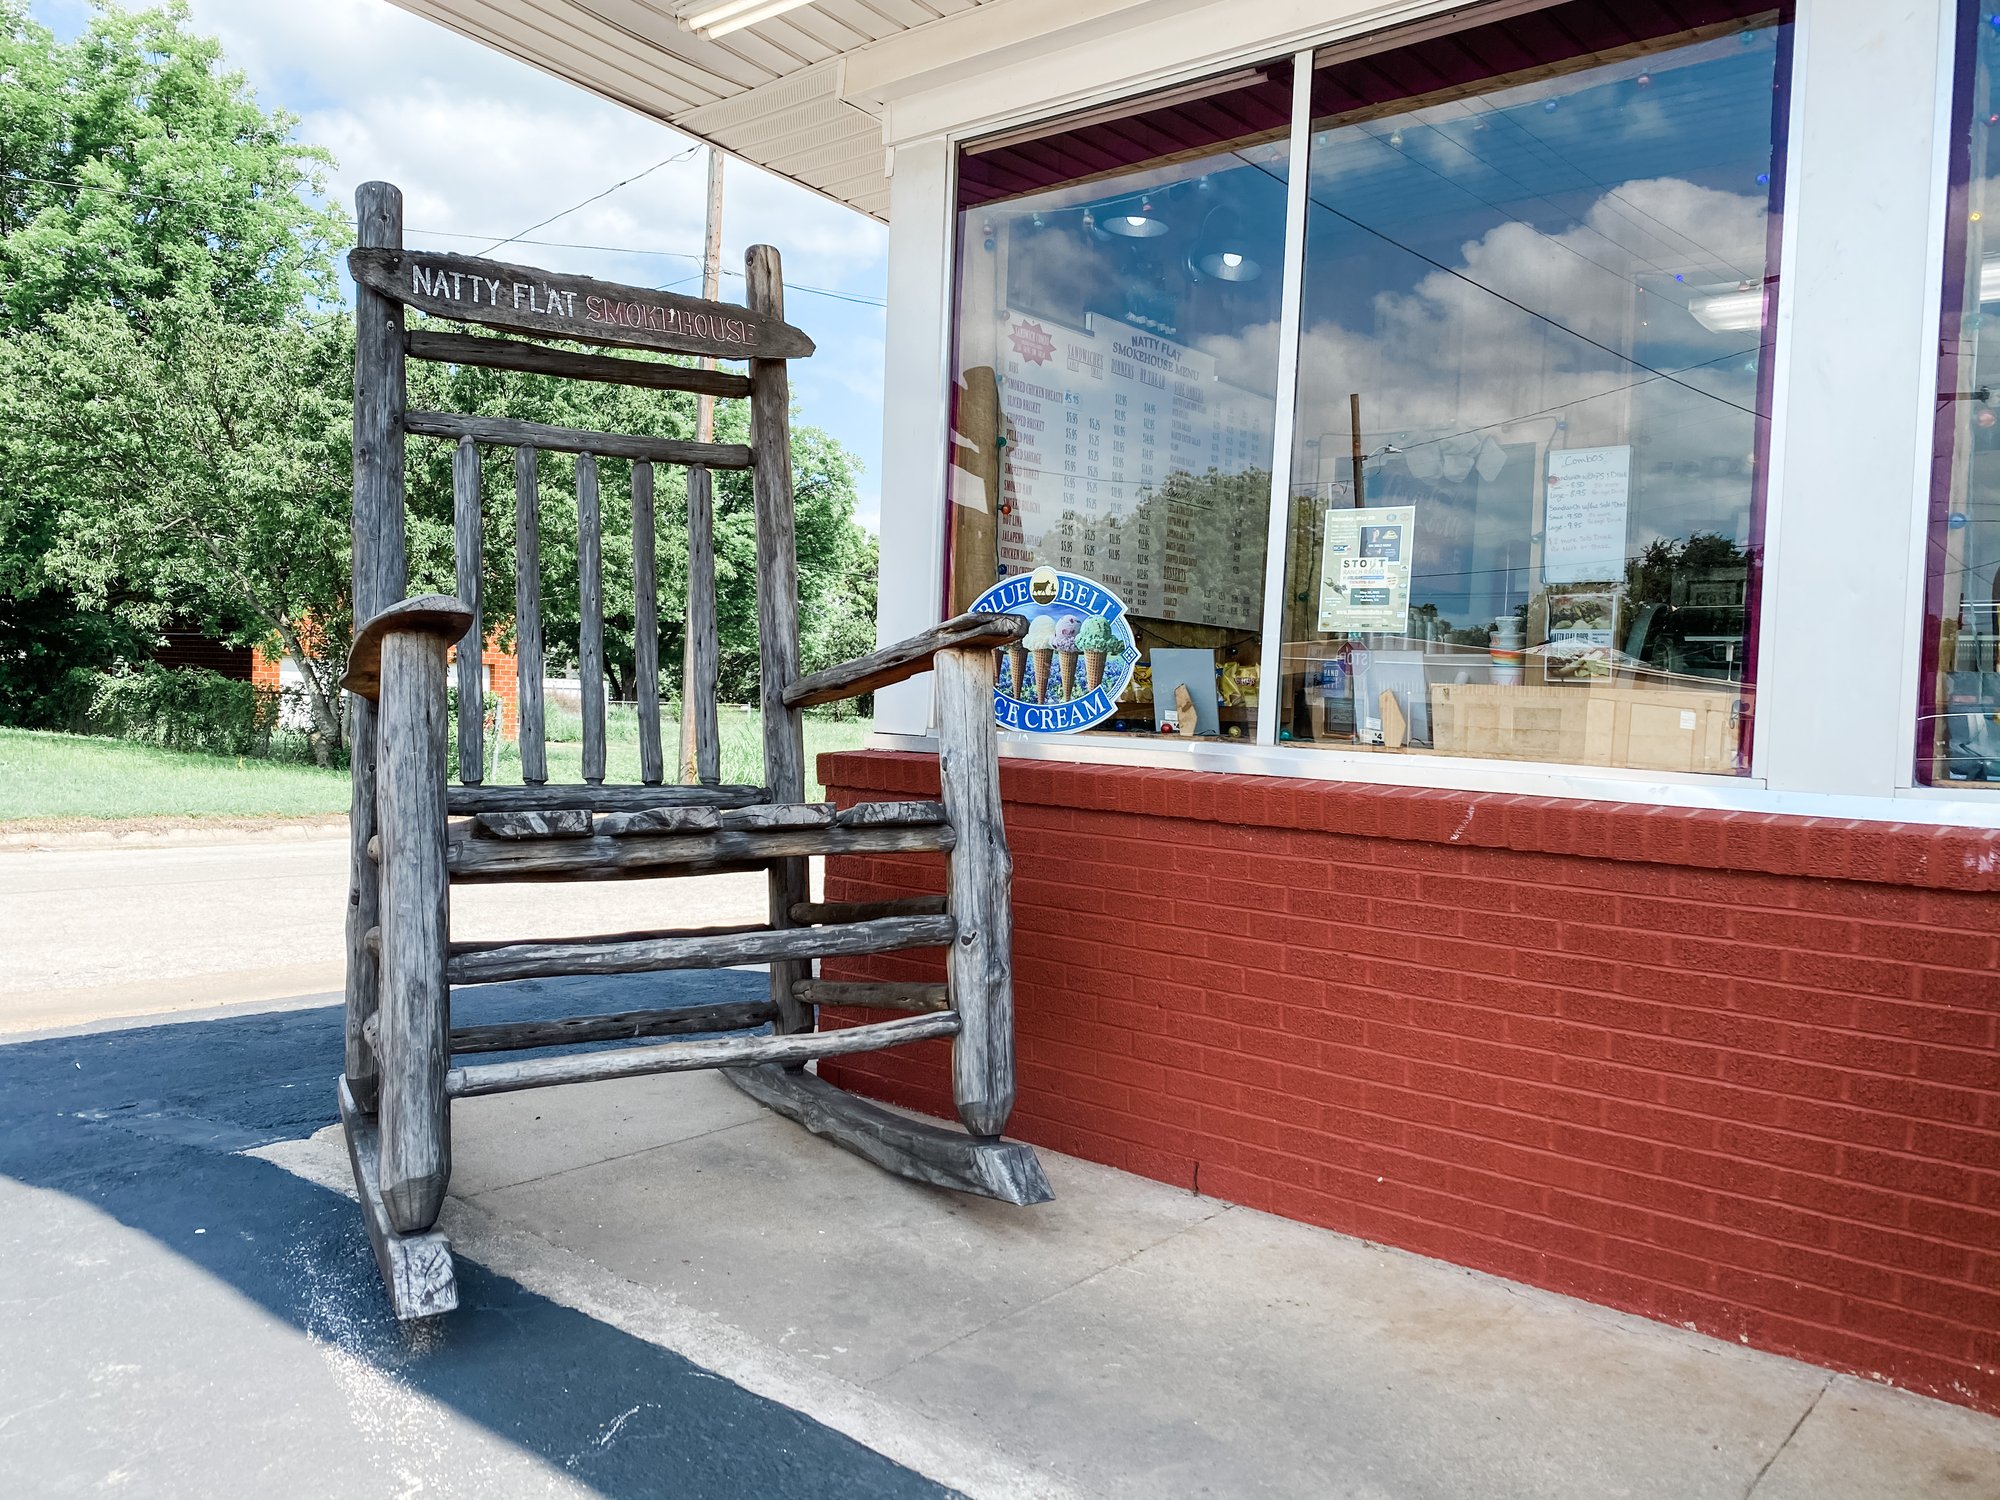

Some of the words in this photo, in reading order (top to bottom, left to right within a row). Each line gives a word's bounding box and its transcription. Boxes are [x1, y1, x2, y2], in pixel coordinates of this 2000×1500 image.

[412, 265, 500, 306] NATTY
[512, 282, 578, 318] FLAT
[585, 295, 758, 346] SMOKEHOUSE
[1068, 343, 1104, 368] SANDWICHES
[1131, 335, 1160, 352] NATTY
[1161, 342, 1183, 362] FLAT
[1112, 341, 1174, 373] SMOKEHOUSE
[1174, 364, 1200, 382] MENU
[1065, 443, 1077, 457] $5.95
[1088, 449, 1099, 462] $5.25
[1065, 460, 1076, 473] $5.95
[1088, 465, 1098, 478] $5.25
[1061, 540, 1073, 552] $5.95
[1060, 556, 1072, 568] $5.95
[1083, 560, 1094, 571] $5.25
[1102, 574, 1122, 584] DRINKS
[977, 581, 1029, 613] BLUE
[994, 696, 1020, 724] CE
[1024, 692, 1107, 729] CREAM
